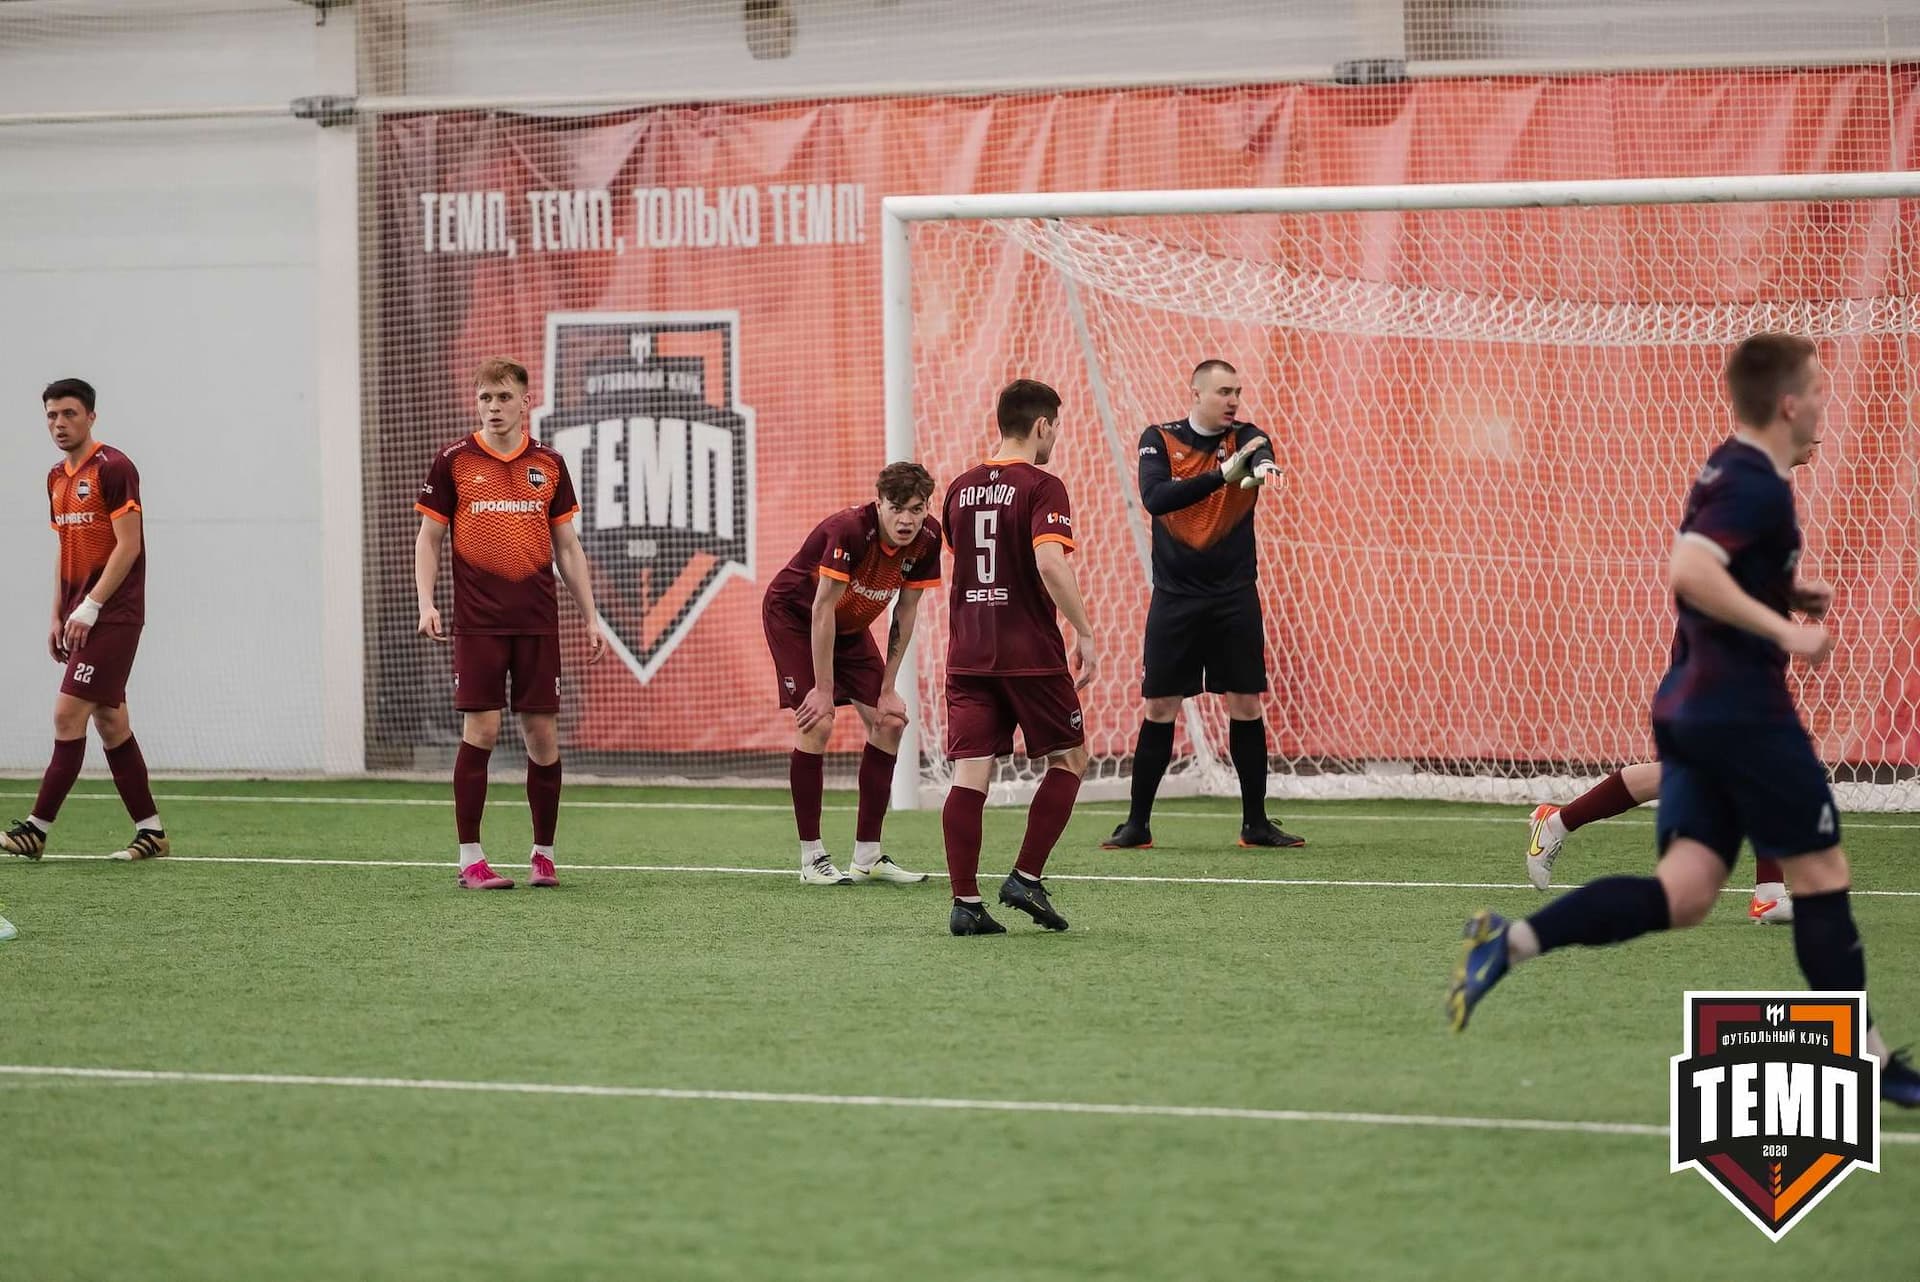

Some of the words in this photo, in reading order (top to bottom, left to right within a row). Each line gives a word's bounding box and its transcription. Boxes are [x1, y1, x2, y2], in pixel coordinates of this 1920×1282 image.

[421, 191, 517, 258] ТЕМП,
[527, 188, 625, 256] ТЕМП,
[633, 186, 760, 249] ТОЛЬКО
[768, 183, 867, 246] ТЕМП!
[553, 417, 734, 541] ТЕМП
[959, 484, 1016, 508] БОРИСОВ
[975, 510, 997, 583] 5
[966, 588, 1008, 602] SELS
[73, 663, 95, 684] 22
